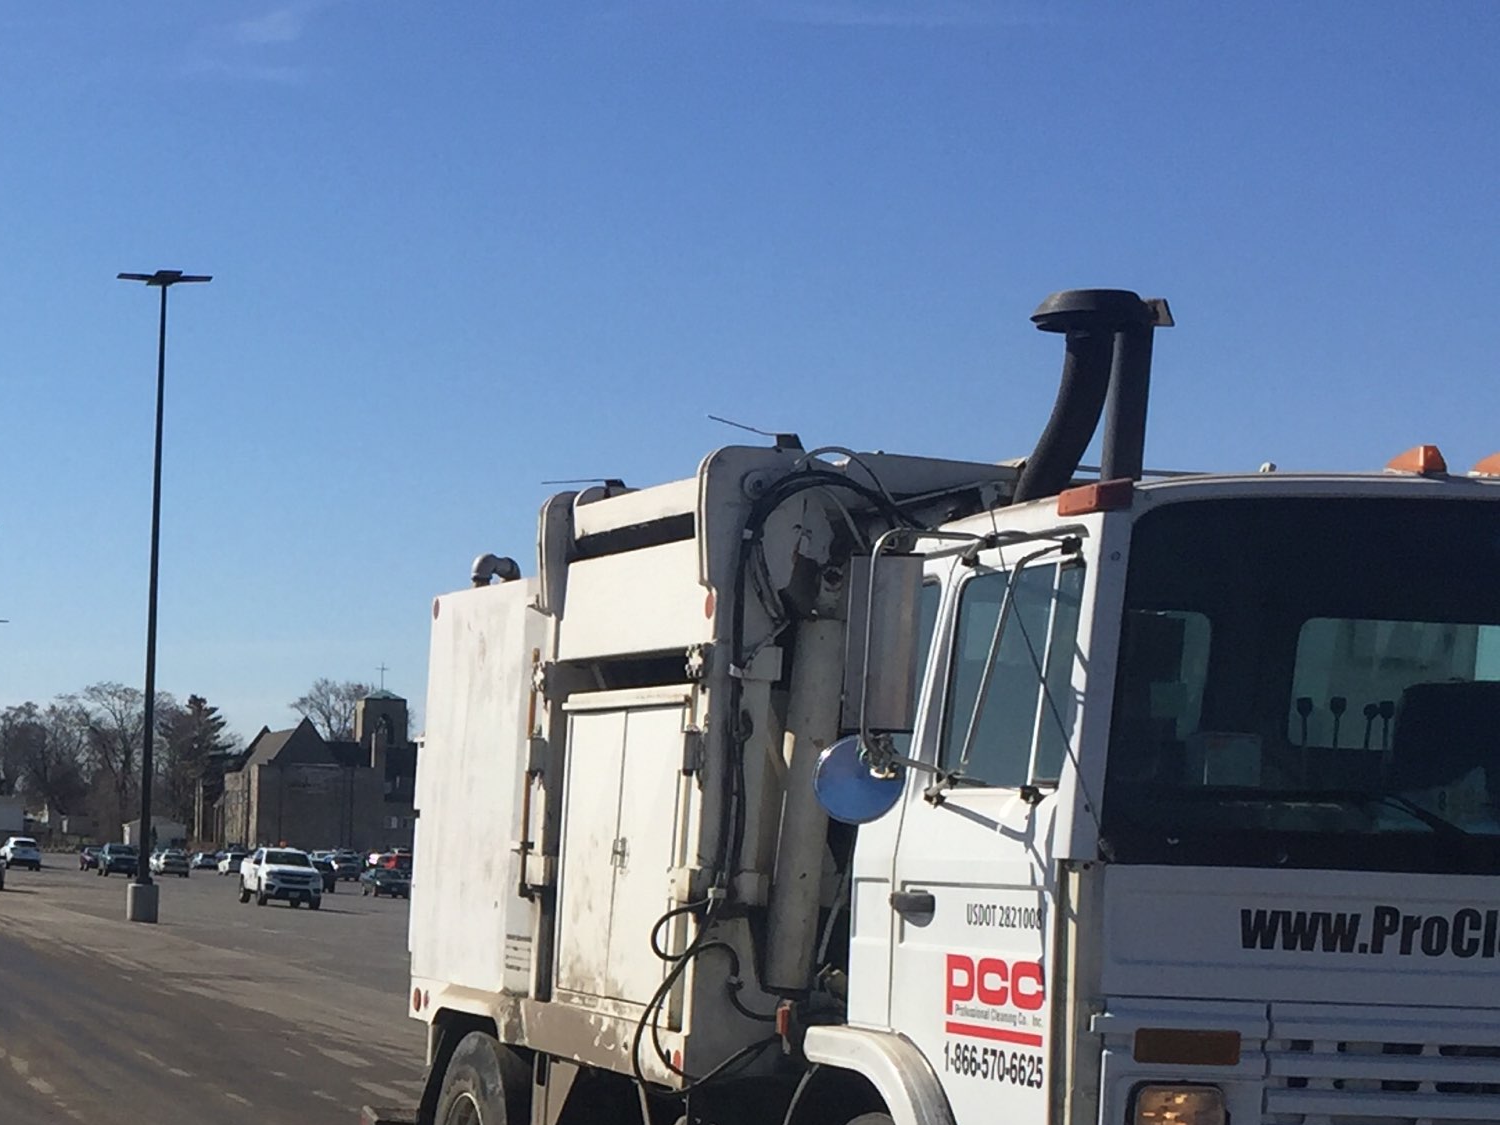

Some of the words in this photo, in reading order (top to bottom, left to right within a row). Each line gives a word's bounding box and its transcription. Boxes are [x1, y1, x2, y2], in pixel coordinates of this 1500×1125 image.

[966, 903, 997, 926] USDOT
[1240, 905, 1500, 958] www.ProCl
[944, 1040, 1043, 1089] 1-866-570-6625
